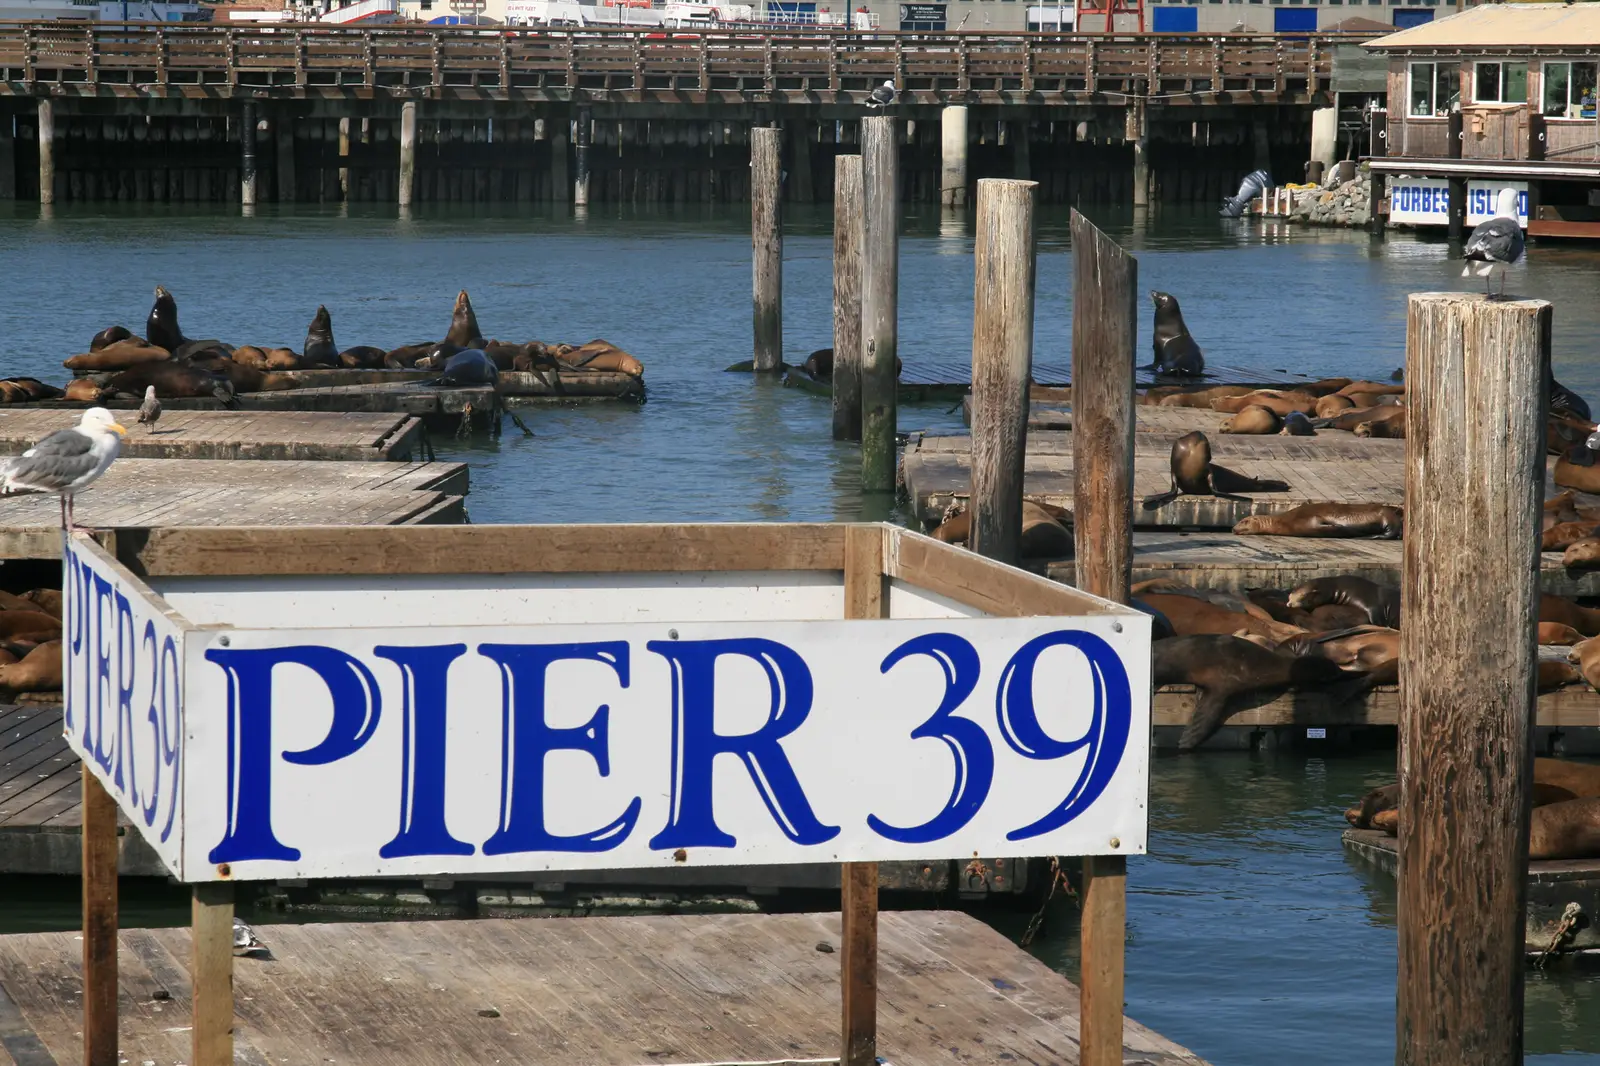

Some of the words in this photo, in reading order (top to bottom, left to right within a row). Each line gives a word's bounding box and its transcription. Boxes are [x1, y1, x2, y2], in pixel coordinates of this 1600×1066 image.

[1392, 186, 1449, 213] FORBES
[1470, 188, 1528, 216] ISLD
[65, 543, 139, 809] PIER
[141, 619, 181, 844] 39
[206, 638, 840, 863] PIER
[868, 630, 1132, 843] 39
